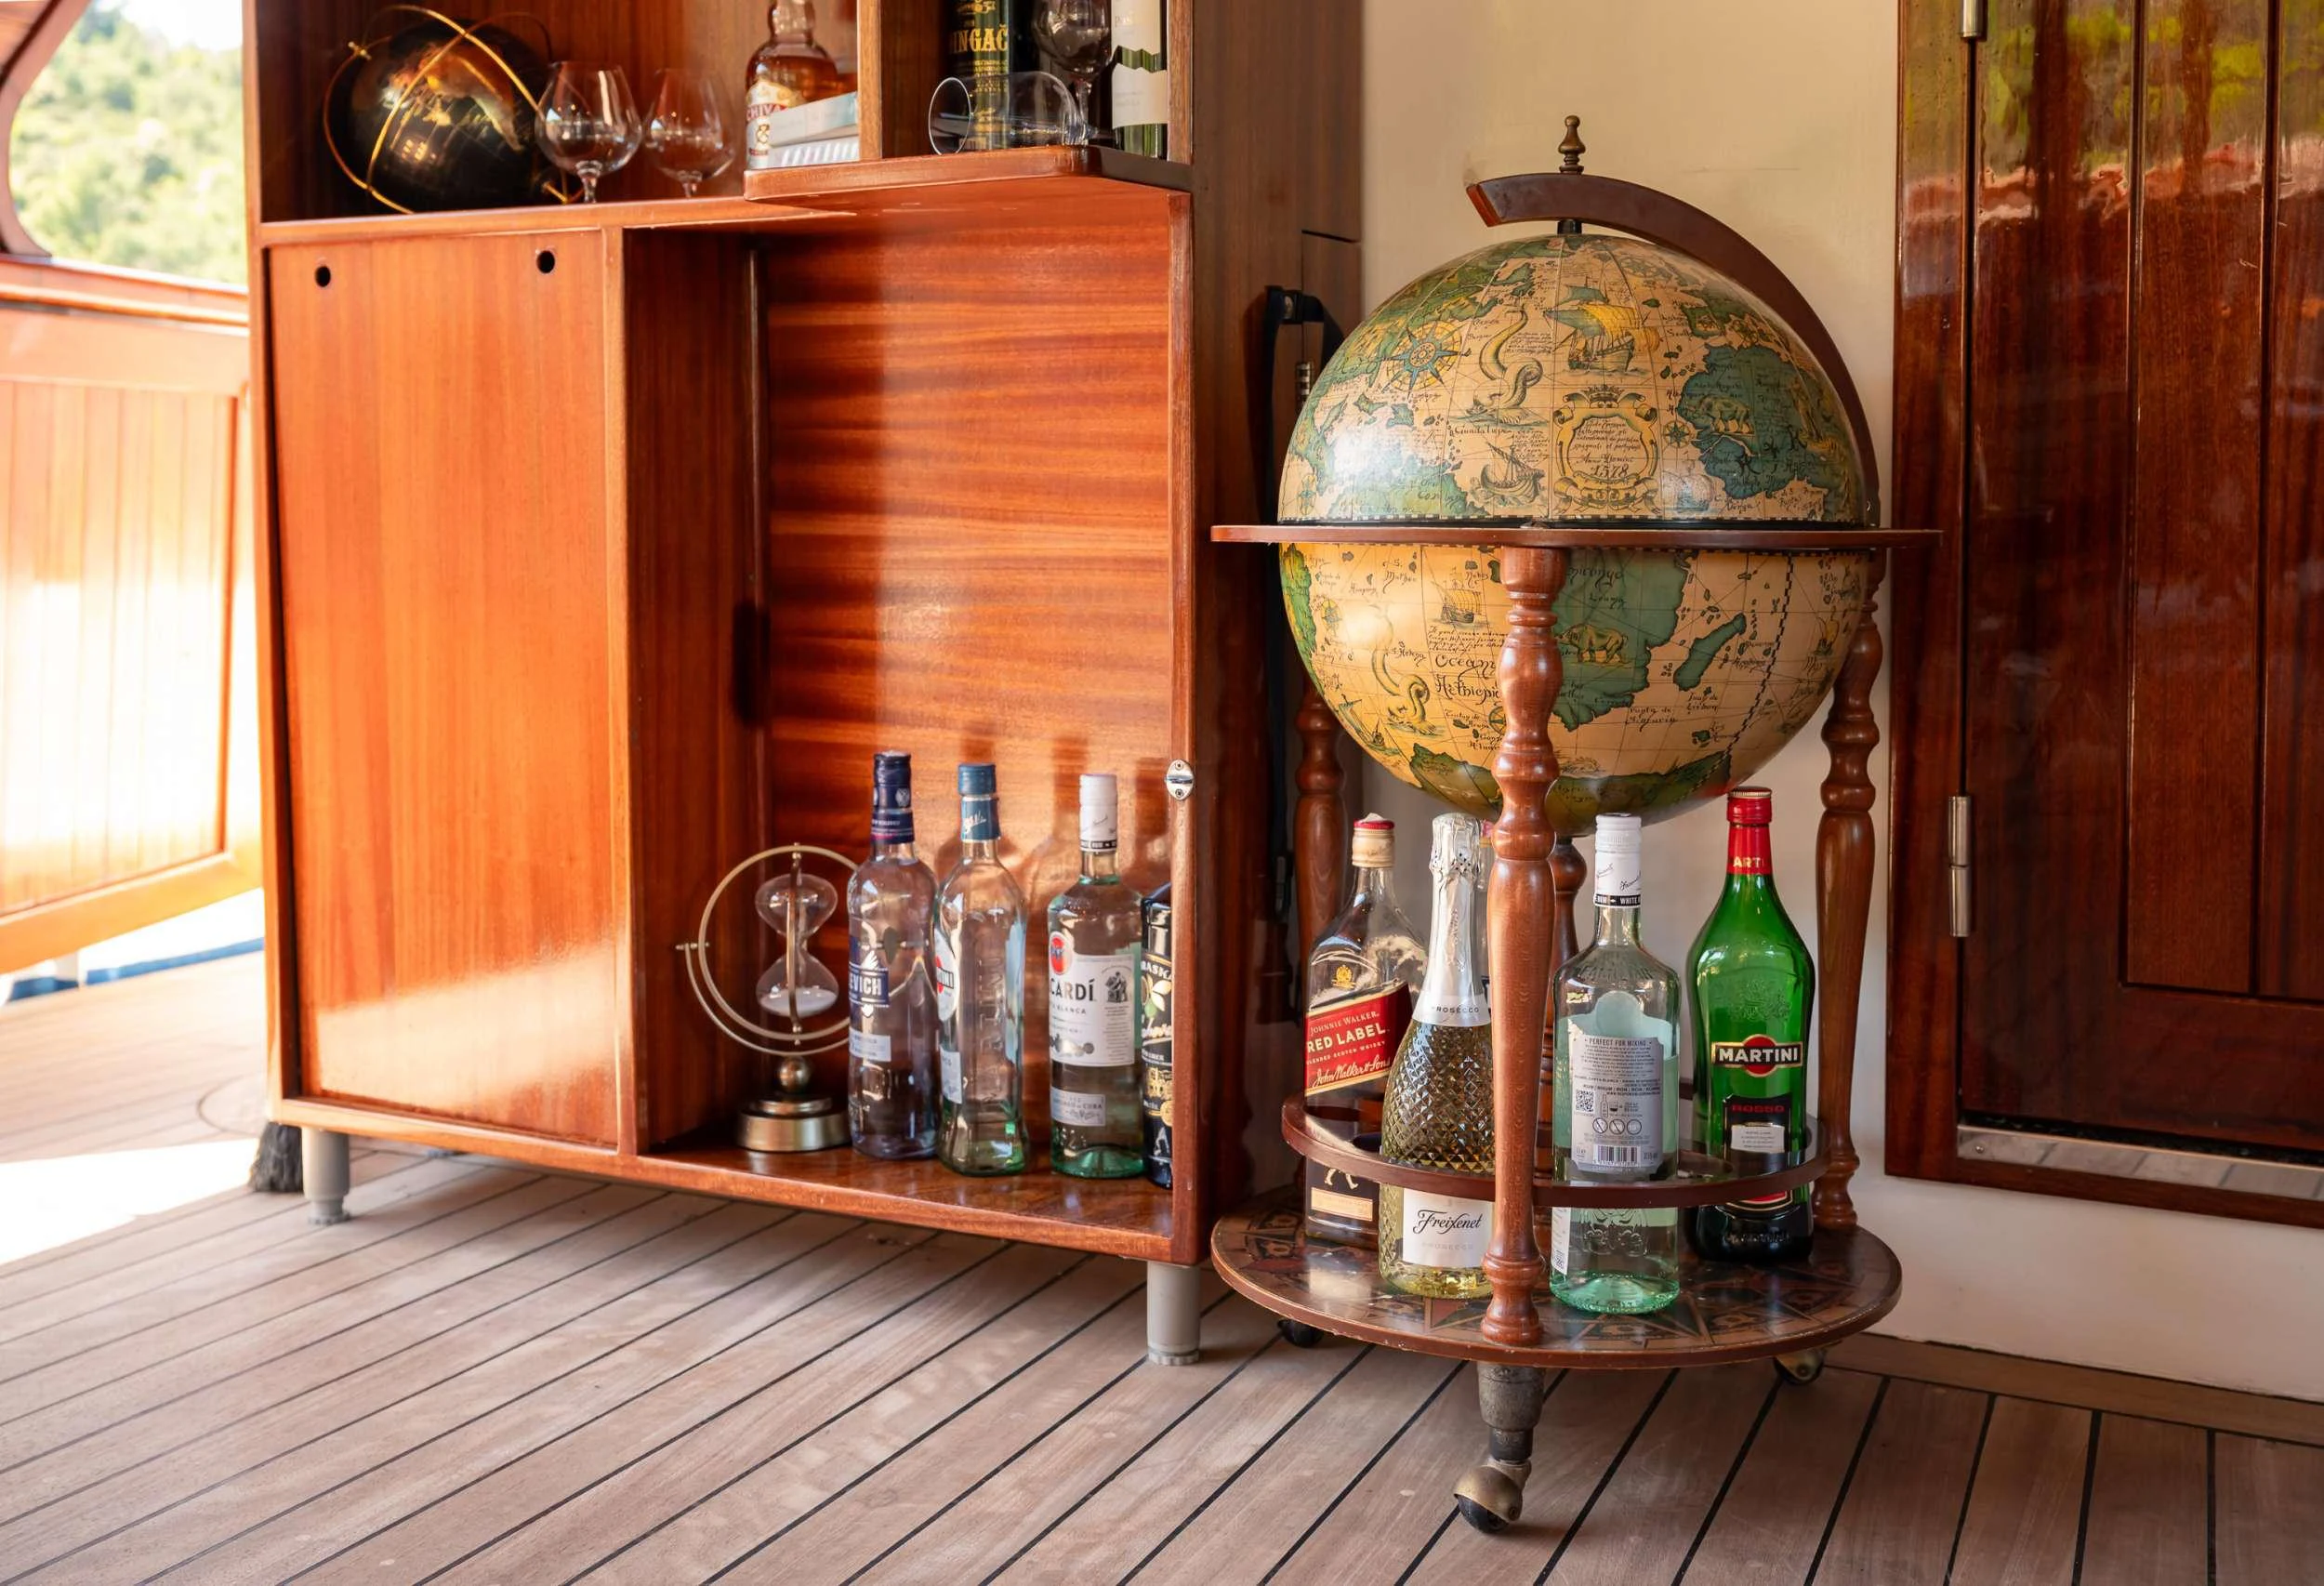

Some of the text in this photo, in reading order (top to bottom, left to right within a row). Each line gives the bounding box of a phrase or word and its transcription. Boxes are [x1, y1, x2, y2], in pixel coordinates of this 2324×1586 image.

[1733, 856, 1764, 867] ARTI
[1310, 1021, 1341, 1037] JOHNNIE
[1306, 1023, 1386, 1053] RED LABEL
[1589, 1038, 1614, 1047] PERFECT
[1719, 1047, 1798, 1063] MARTINI
[1731, 1104, 1785, 1114] ROSSO
[1412, 1209, 1483, 1236] Freixenet
